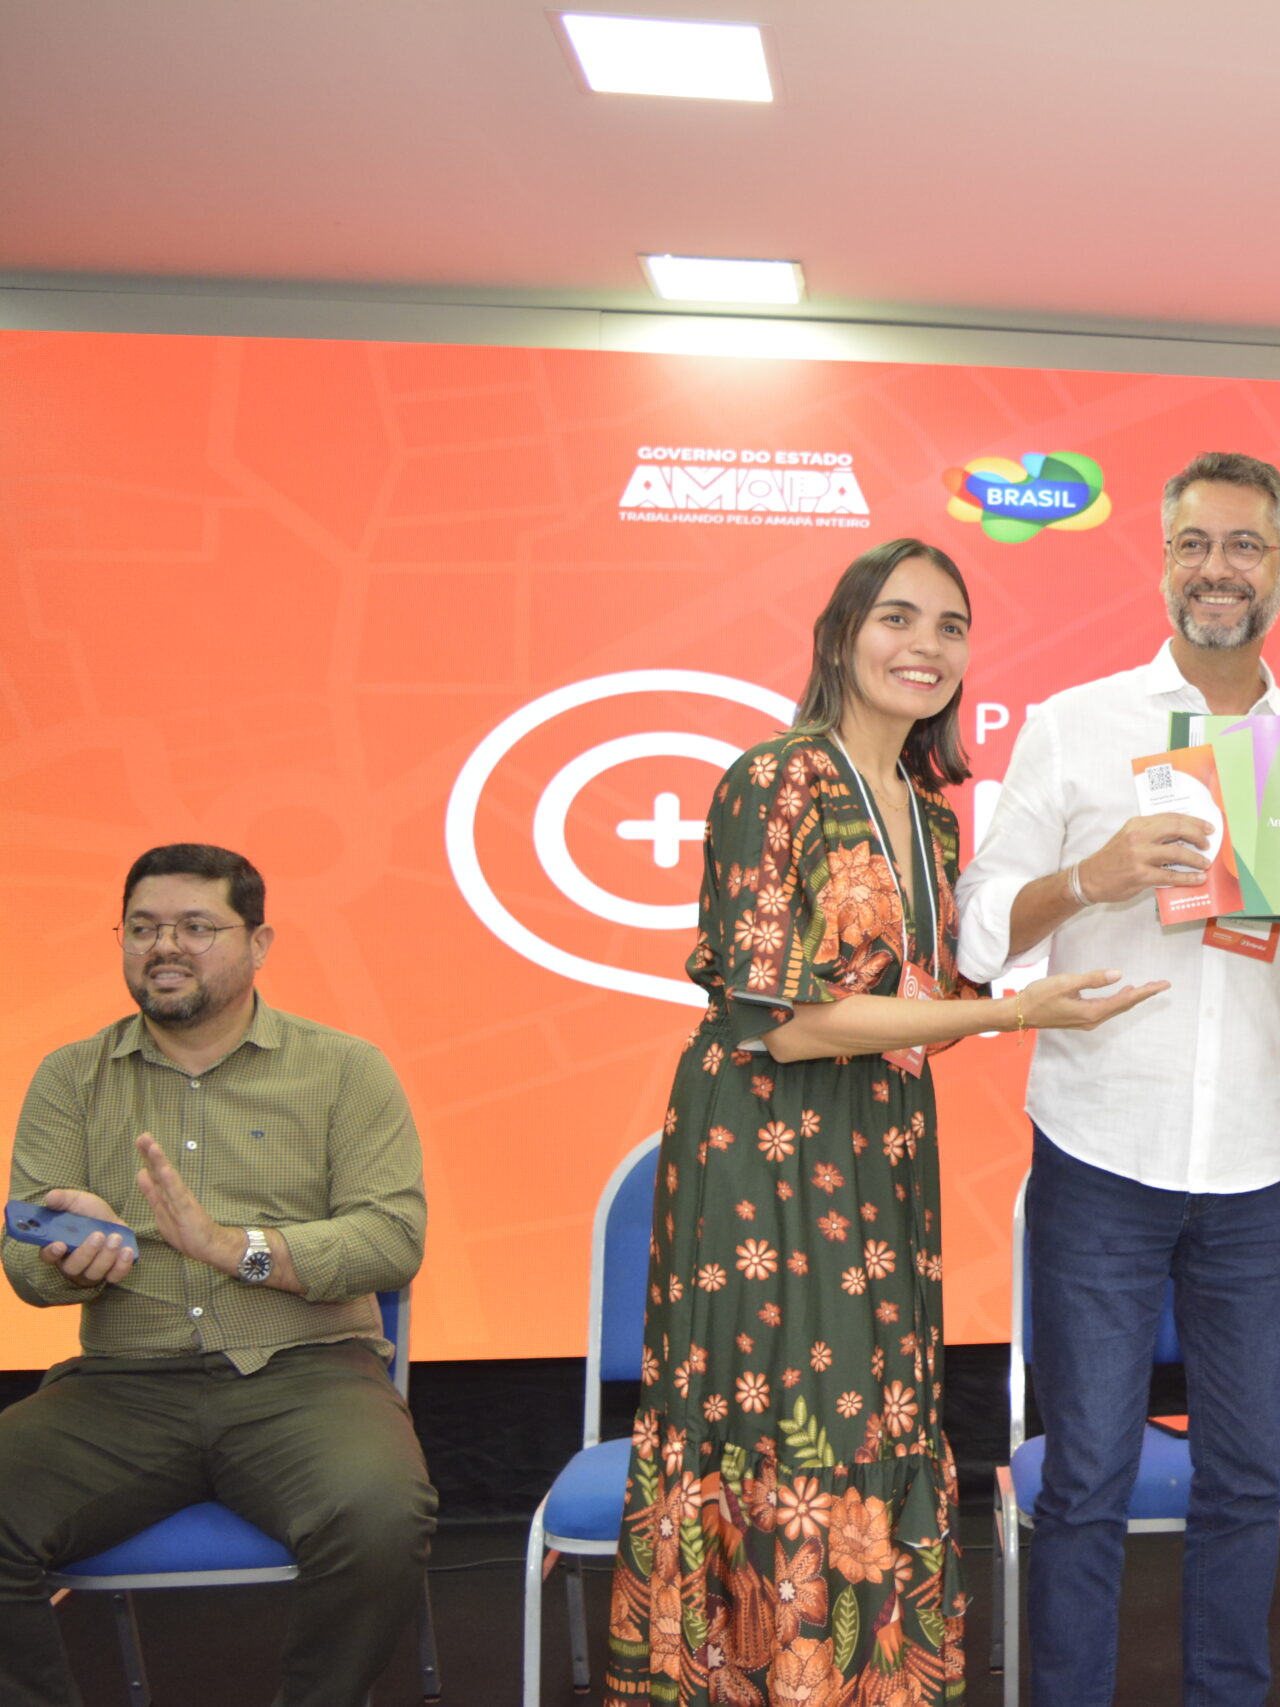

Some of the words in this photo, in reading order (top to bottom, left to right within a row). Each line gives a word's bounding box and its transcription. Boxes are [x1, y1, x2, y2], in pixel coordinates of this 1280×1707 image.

[637, 446, 737, 462] GOVERNO
[740, 450, 771, 464] DO
[774, 451, 853, 466] ESTADO
[986, 487, 1077, 508] BRASIL
[619, 511, 724, 524] TRABALHANDO
[726, 514, 763, 526] PELO
[815, 516, 870, 529] INTEIRO
